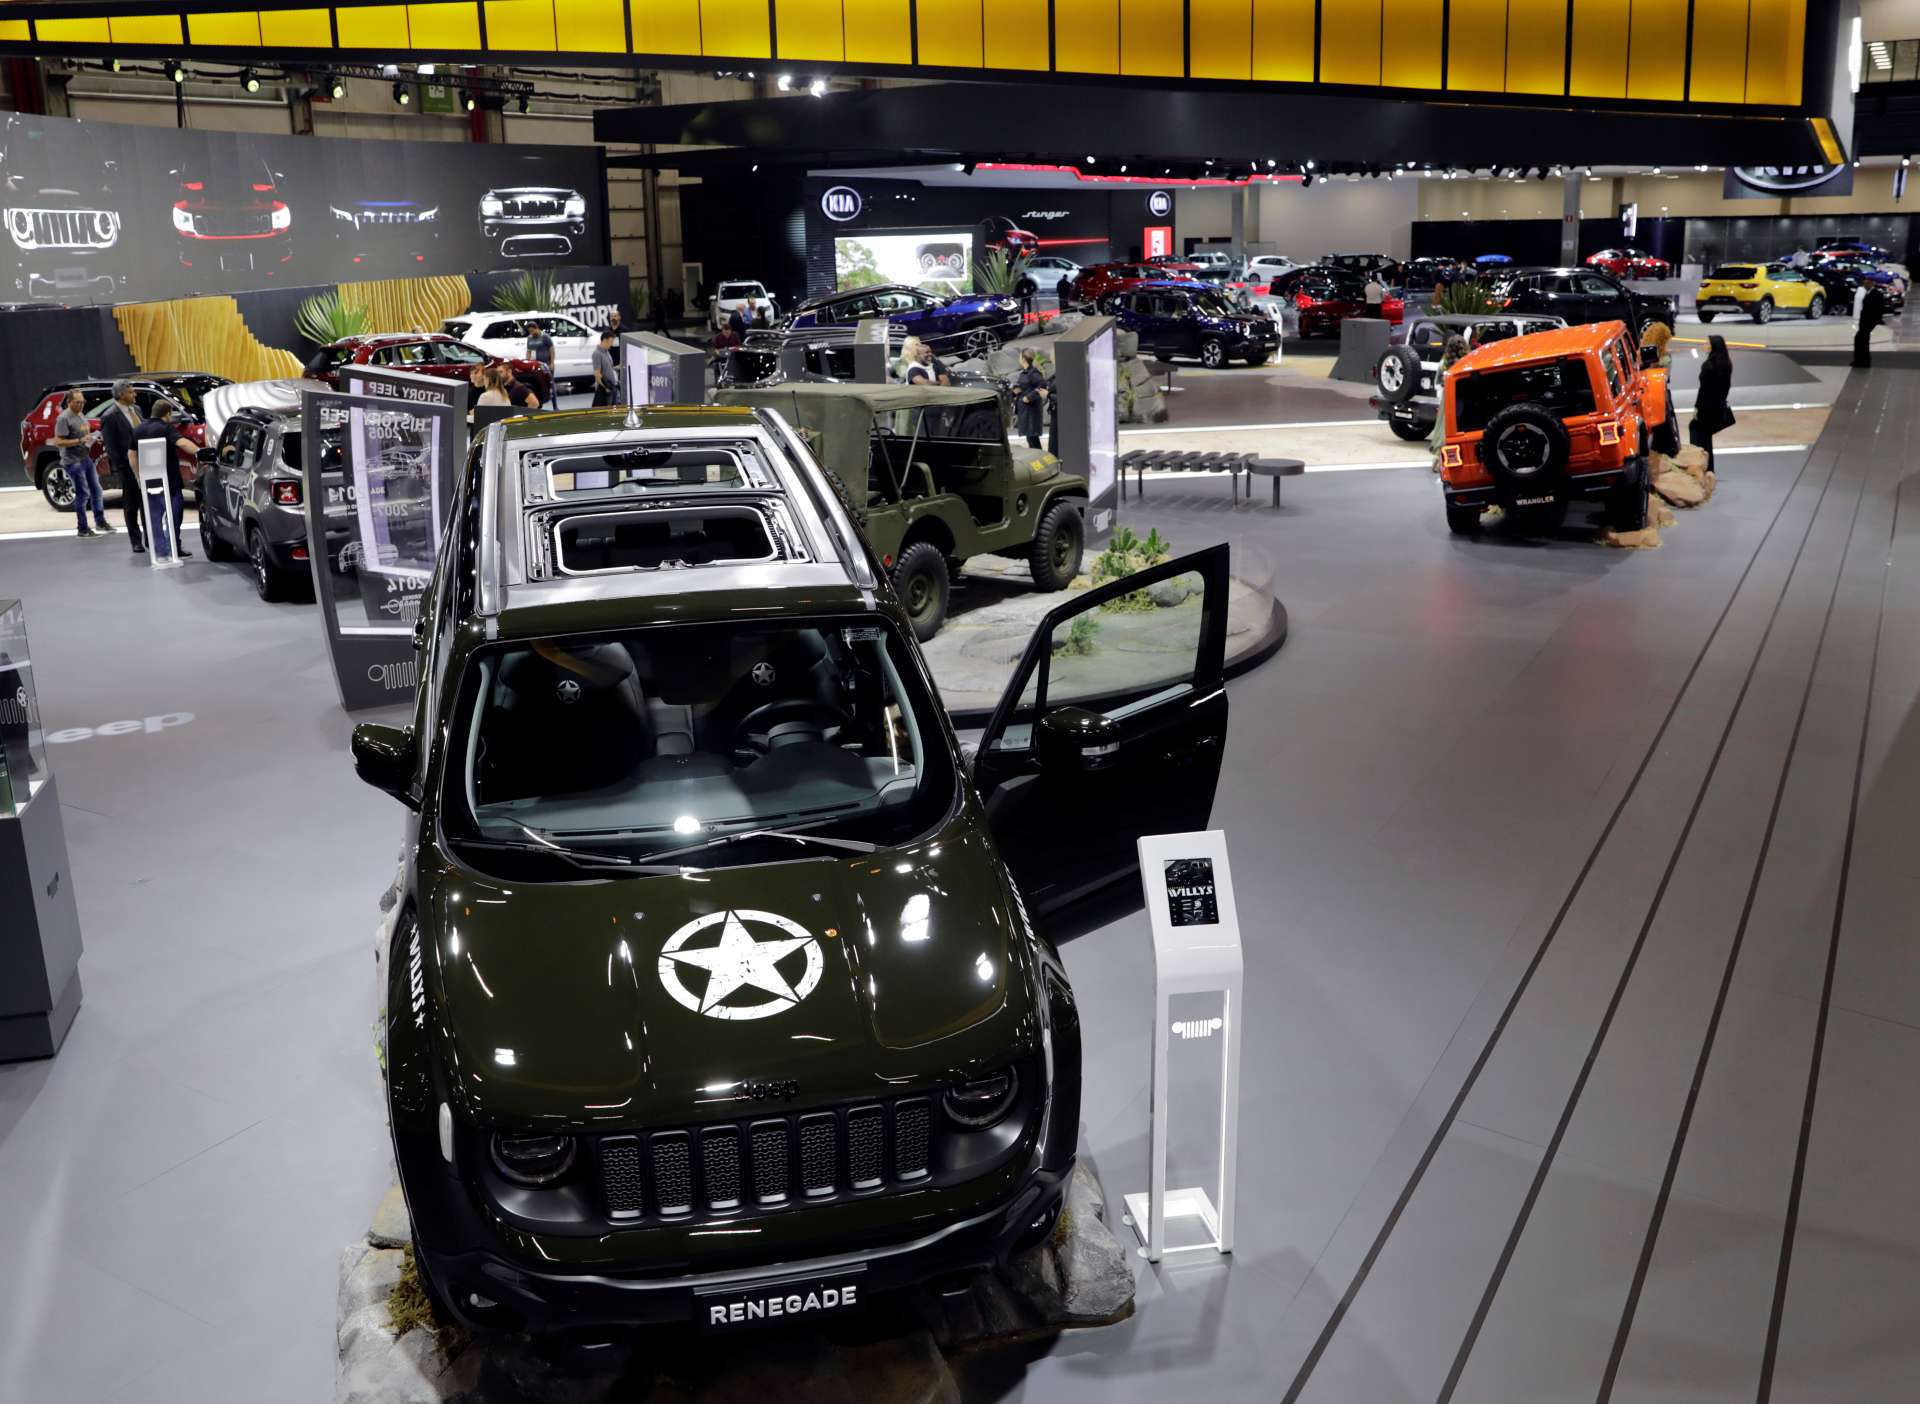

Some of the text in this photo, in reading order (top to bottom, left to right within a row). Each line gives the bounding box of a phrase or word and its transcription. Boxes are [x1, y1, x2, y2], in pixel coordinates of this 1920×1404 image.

[1021, 210, 1070, 220] stinger
[549, 281, 596, 306] MAKE
[1516, 495, 1556, 507] WRANGLER
[46, 712, 196, 744] eep
[1168, 886, 1213, 898] WILLYS
[409, 929, 426, 1013] WILLYS
[710, 1286, 857, 1325] RENEGADE
